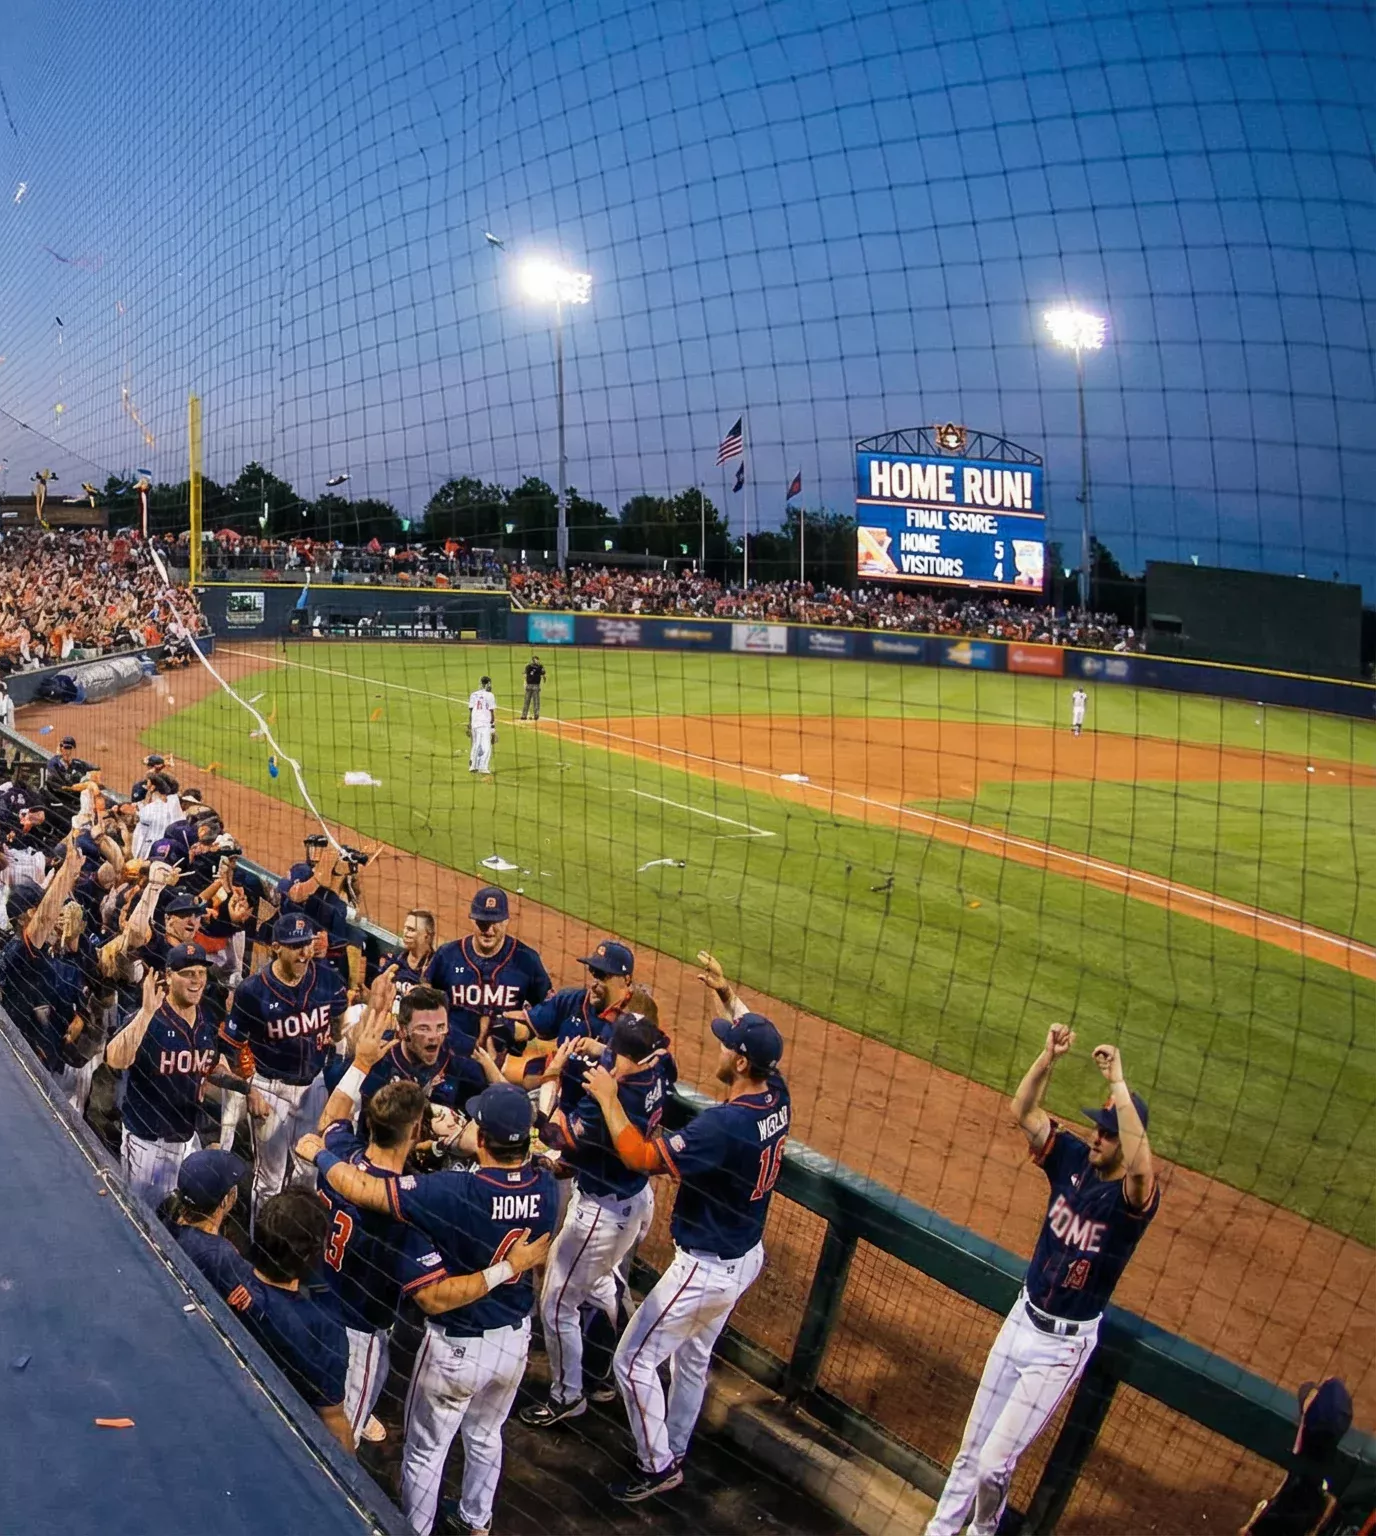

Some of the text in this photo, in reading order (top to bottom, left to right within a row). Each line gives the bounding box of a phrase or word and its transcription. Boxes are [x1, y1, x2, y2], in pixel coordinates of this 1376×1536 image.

[870, 460, 1032, 509] HOME RUN!
[906, 508, 946, 530] FINAL
[900, 533, 1004, 560] HOME 5
[900, 555, 1004, 582] VISITORS 4
[451, 983, 520, 1007] HOME
[267, 1004, 331, 1039] HOME
[492, 1194, 541, 1220] HOME
